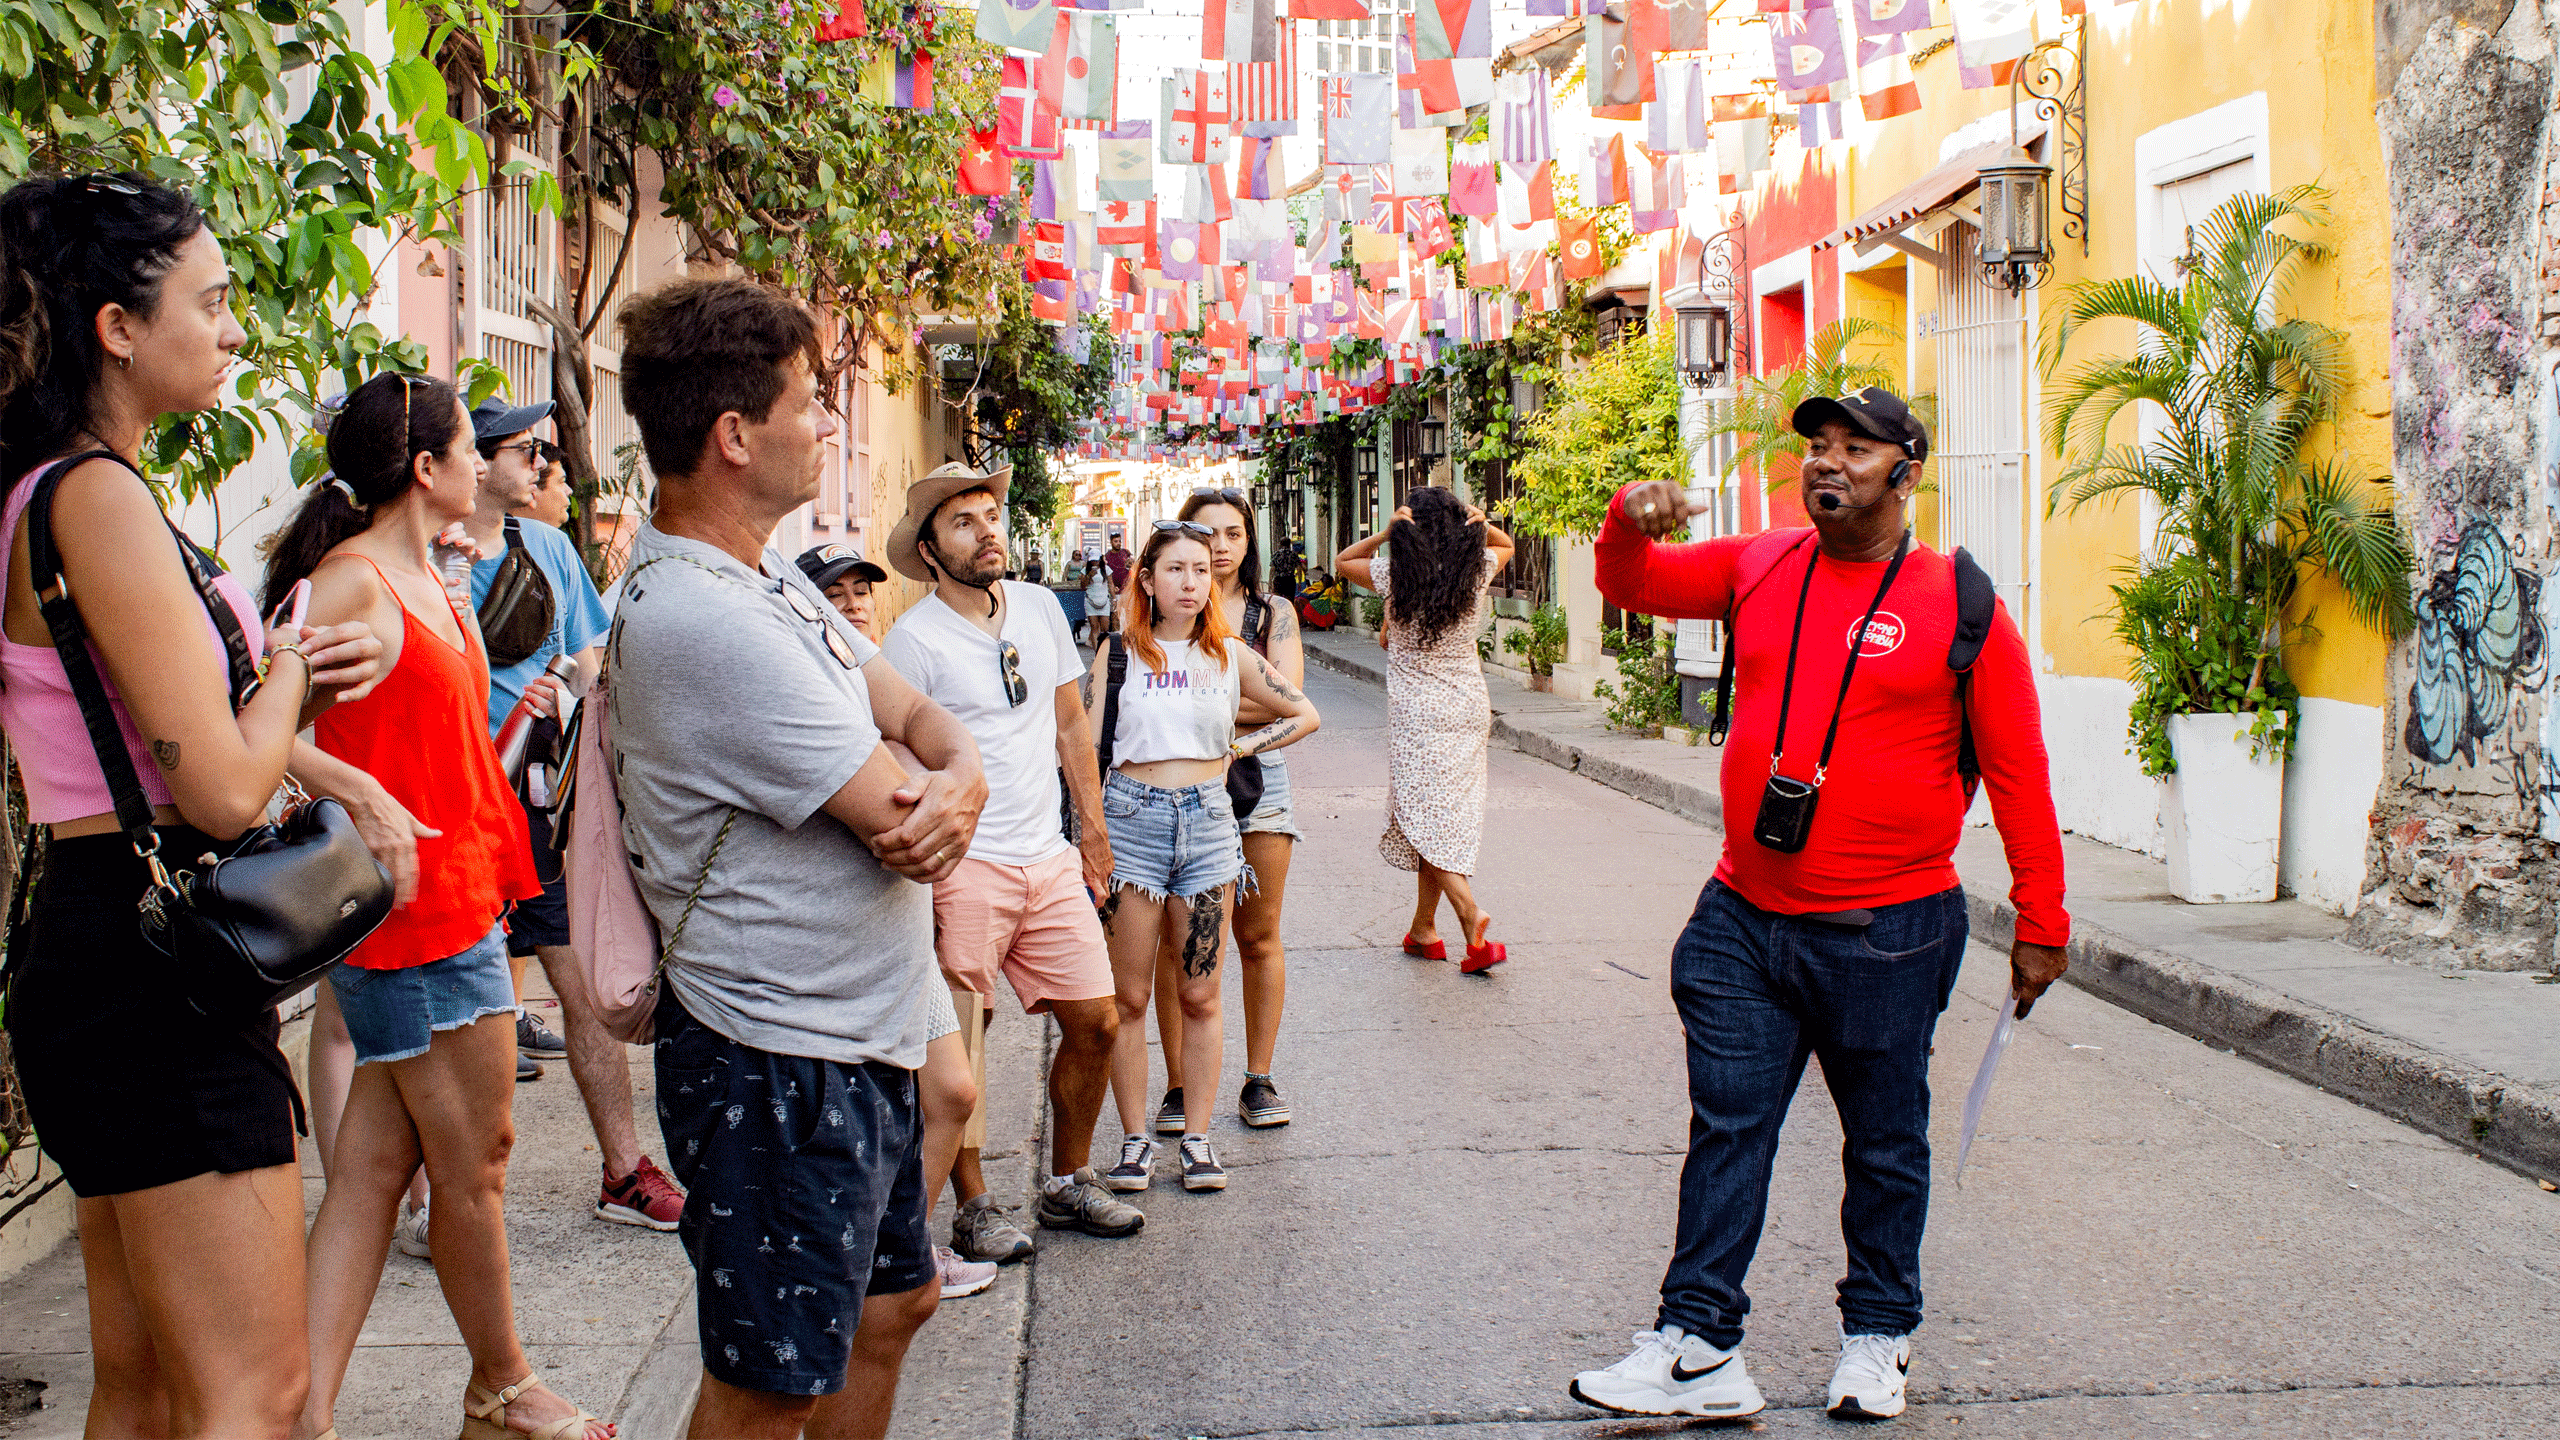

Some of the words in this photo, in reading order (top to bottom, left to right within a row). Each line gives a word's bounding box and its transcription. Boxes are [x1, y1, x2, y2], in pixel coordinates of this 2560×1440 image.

[1864, 620, 1899, 637] EYOND
[1851, 629, 1895, 649] CLOMBIA
[1143, 668, 1228, 690] TOMMY
[1142, 687, 1229, 698] HILFIGER
[627, 1188, 654, 1213] N
